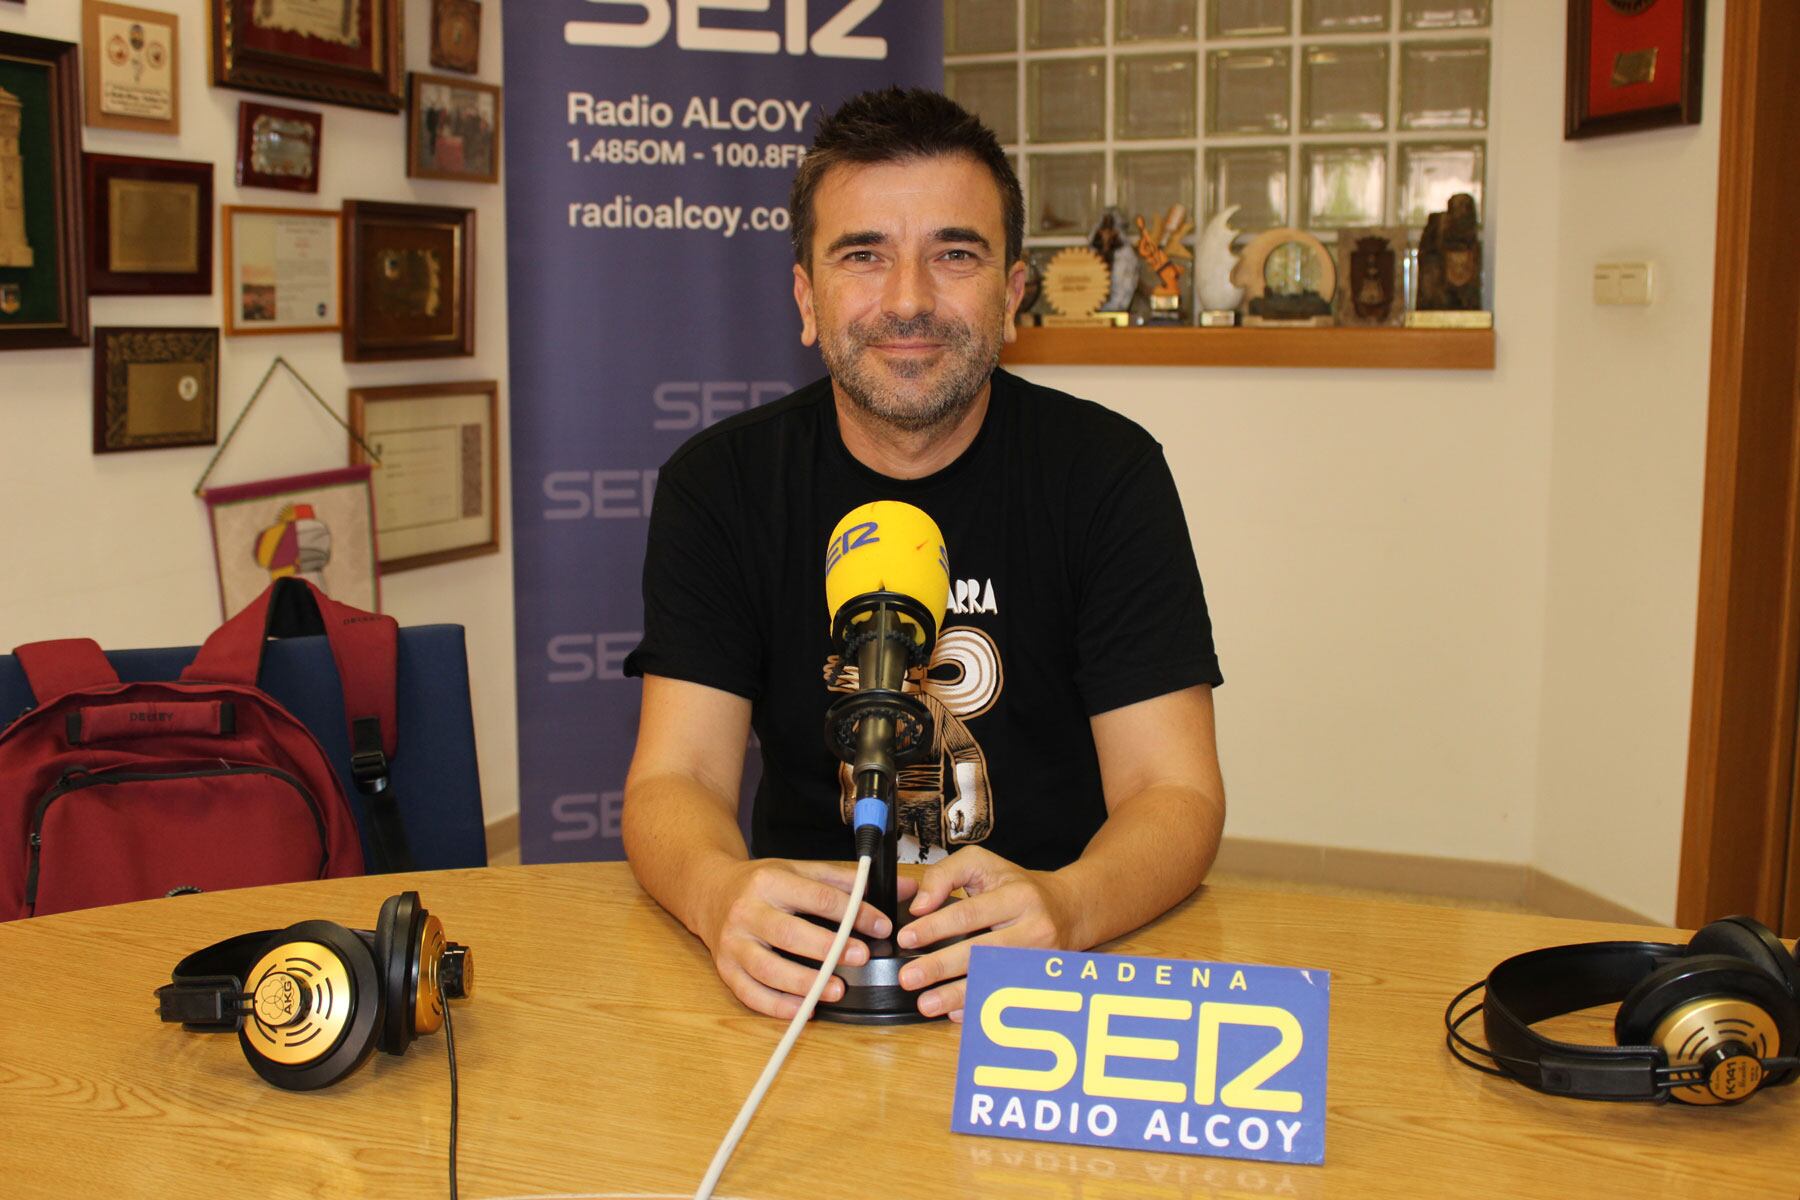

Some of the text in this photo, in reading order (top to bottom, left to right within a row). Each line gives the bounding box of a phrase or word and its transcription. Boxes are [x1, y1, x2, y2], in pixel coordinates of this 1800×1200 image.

[566, 91, 812, 132] Radio ALCOY
[568, 195, 792, 238] radioalcoy.co
[826, 521, 880, 577] ER
[946, 577, 998, 615] ARRA
[547, 632, 644, 683] SE
[1045, 956, 1248, 991] CADENA
[284, 980, 292, 1015] AKG
[973, 986, 1304, 1114] SER
[1726, 1061, 1736, 1096] K141
[969, 1094, 1302, 1153] RADIO ALCOY
